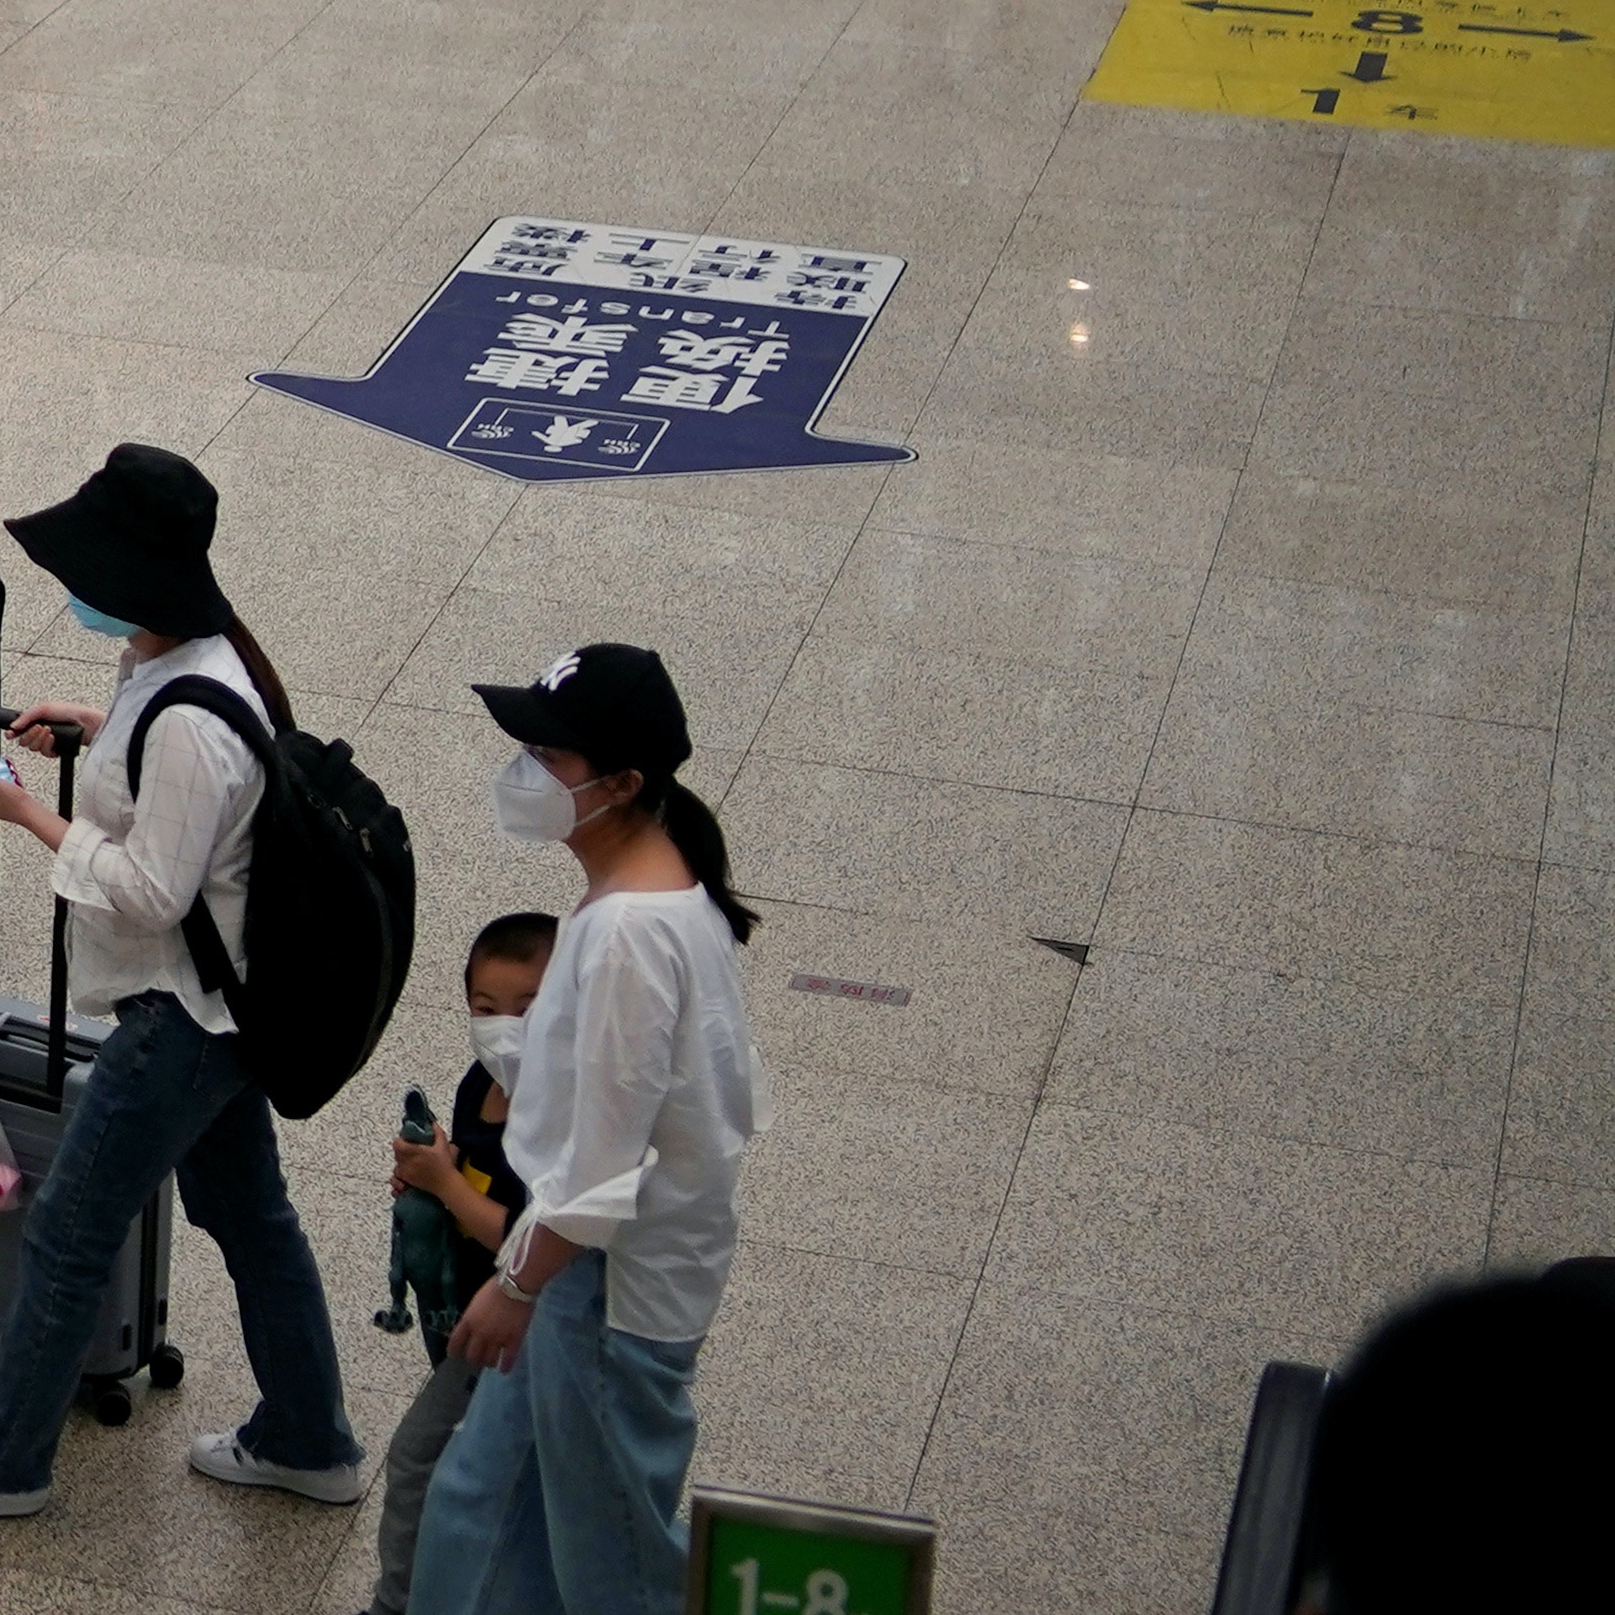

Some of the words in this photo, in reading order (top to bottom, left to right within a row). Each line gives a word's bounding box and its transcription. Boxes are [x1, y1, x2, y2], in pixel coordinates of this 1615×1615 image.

[1350, 8, 1426, 36] 8
[495, 289, 791, 339] Transfer
[497, 312, 791, 377] 换乘
[465, 347, 764, 414] 便捷
